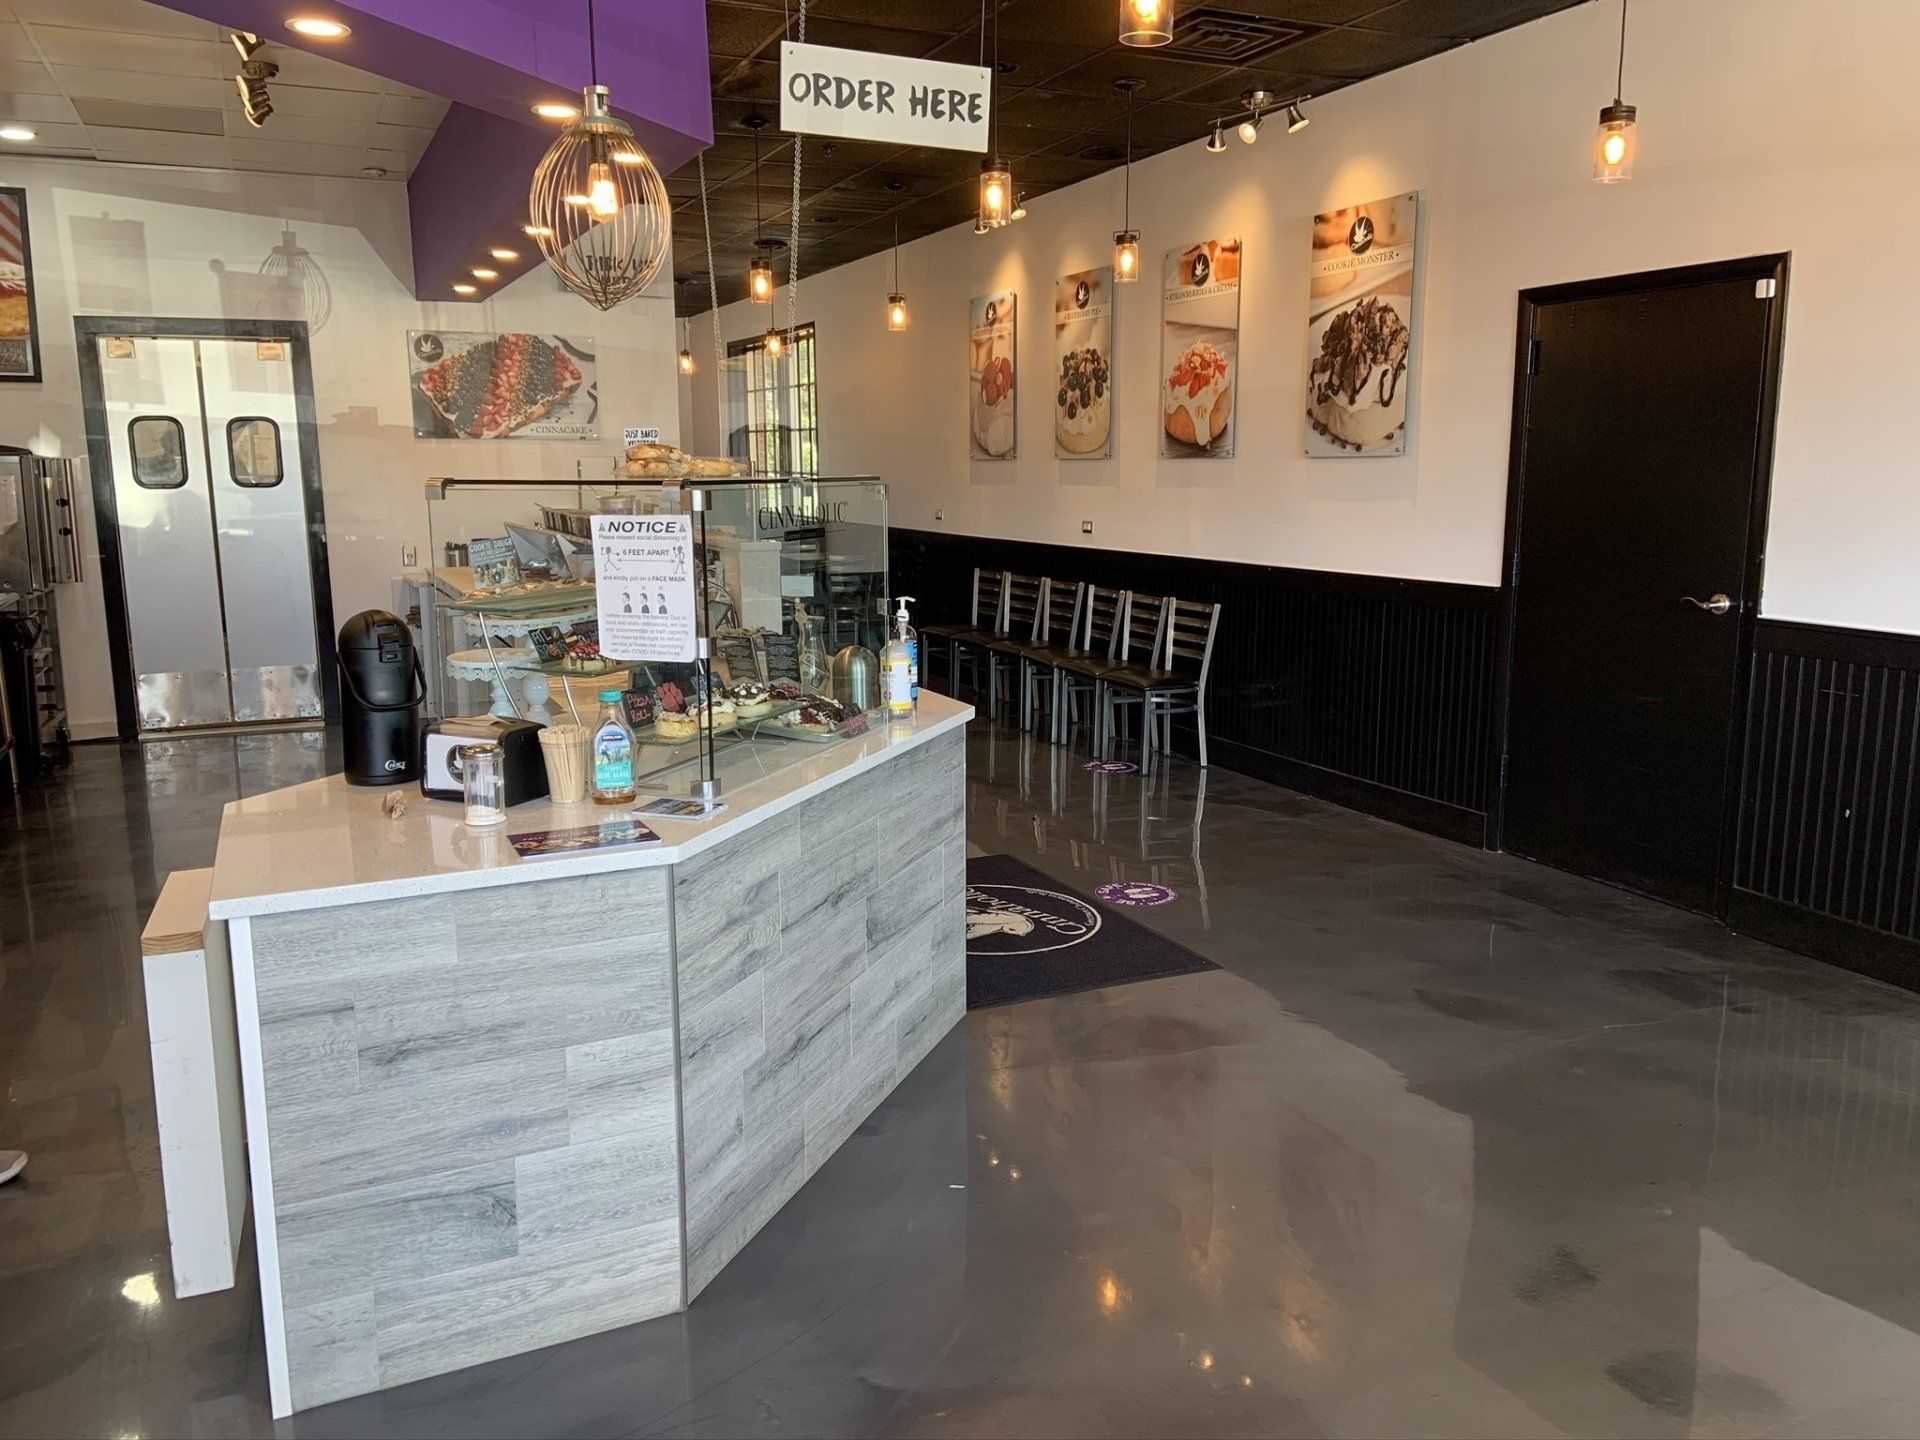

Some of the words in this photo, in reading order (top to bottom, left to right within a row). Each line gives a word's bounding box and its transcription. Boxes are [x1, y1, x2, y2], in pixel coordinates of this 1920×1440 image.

[788, 72, 895, 114] ORDER
[908, 85, 983, 124] HERE
[1327, 259, 1356, 272] COOKIE
[1357, 250, 1394, 268] MONSTER
[535, 425, 588, 435] CINNACAKE
[625, 429, 638, 439] JUST
[640, 429, 659, 439] BAKED
[608, 521, 677, 534] NOTICE
